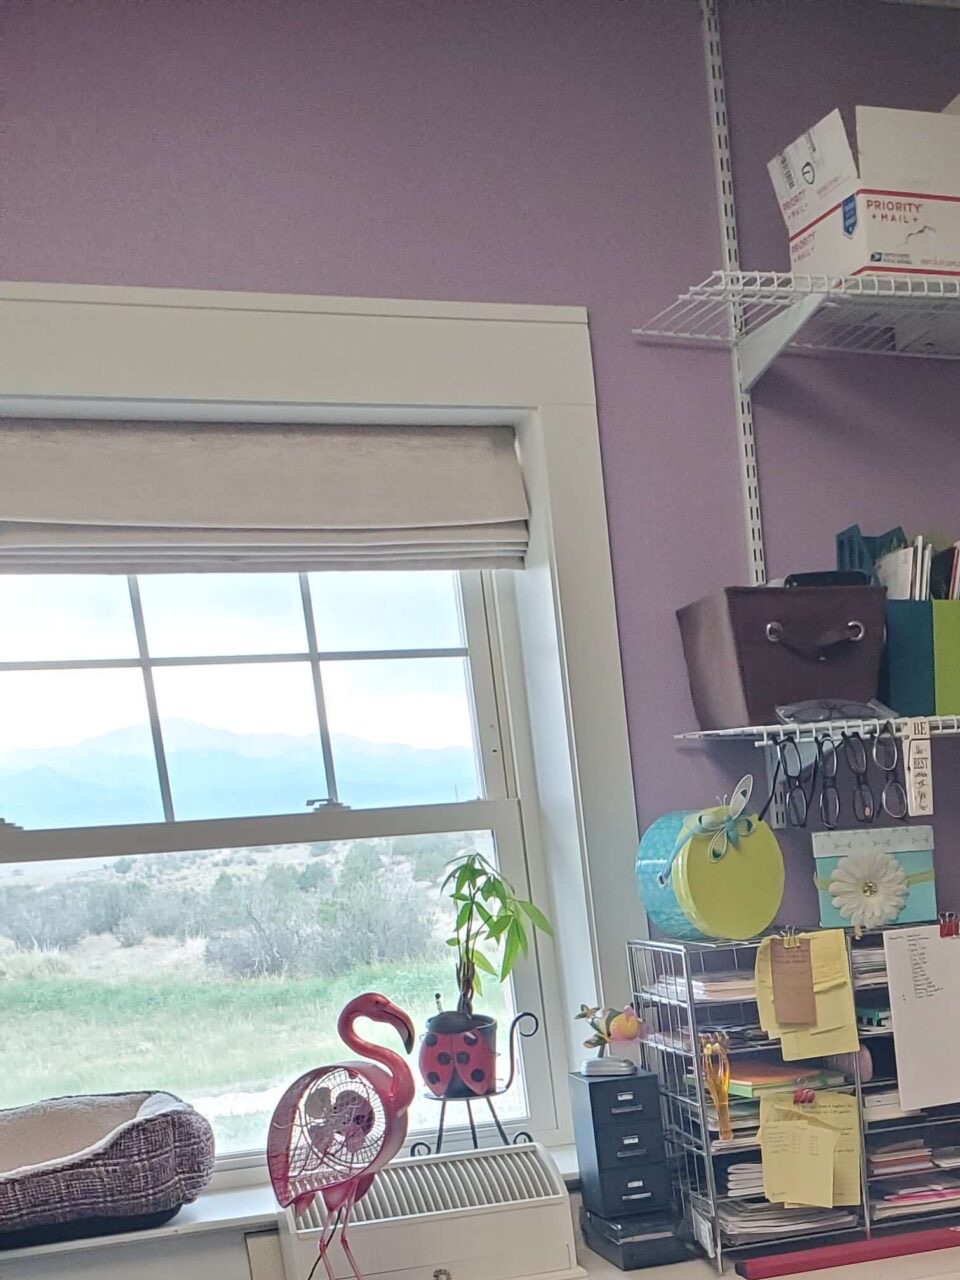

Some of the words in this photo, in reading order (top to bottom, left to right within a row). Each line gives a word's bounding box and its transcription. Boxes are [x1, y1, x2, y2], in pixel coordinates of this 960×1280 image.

[866, 199, 923, 213] PRIORITY
[880, 213, 910, 224] MAIL
[913, 721, 928, 736] BE
[913, 756, 929, 770] BEST
